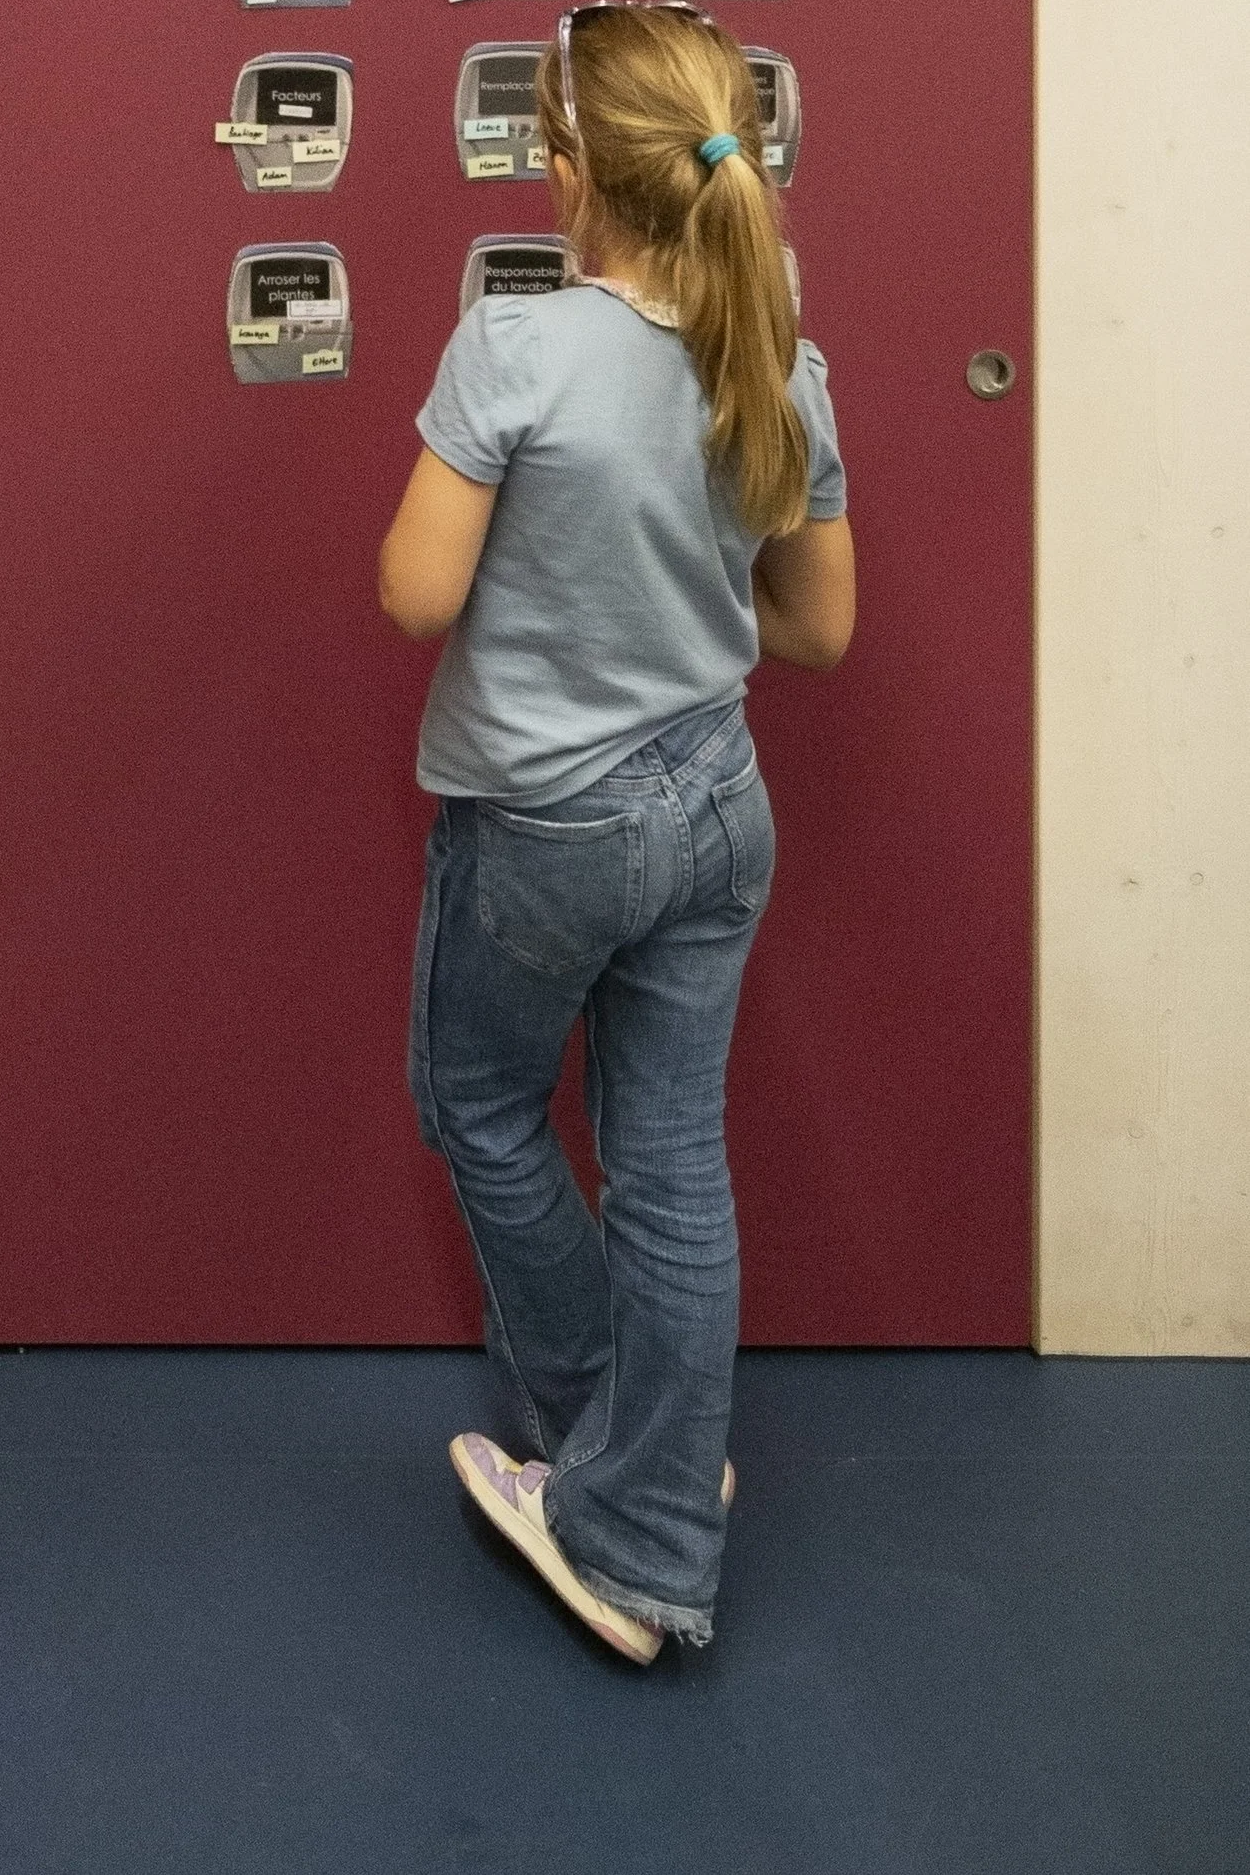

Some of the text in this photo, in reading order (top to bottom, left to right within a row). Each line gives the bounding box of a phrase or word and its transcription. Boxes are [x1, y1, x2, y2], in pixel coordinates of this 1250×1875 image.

[480, 81, 535, 92] Remplaça
[271, 90, 322, 103] Facteurs
[257, 273, 321, 286] Arroser les
[485, 266, 565, 280] Responsables
[491, 281, 553, 293] du lavabo
[268, 290, 316, 304] plantes
